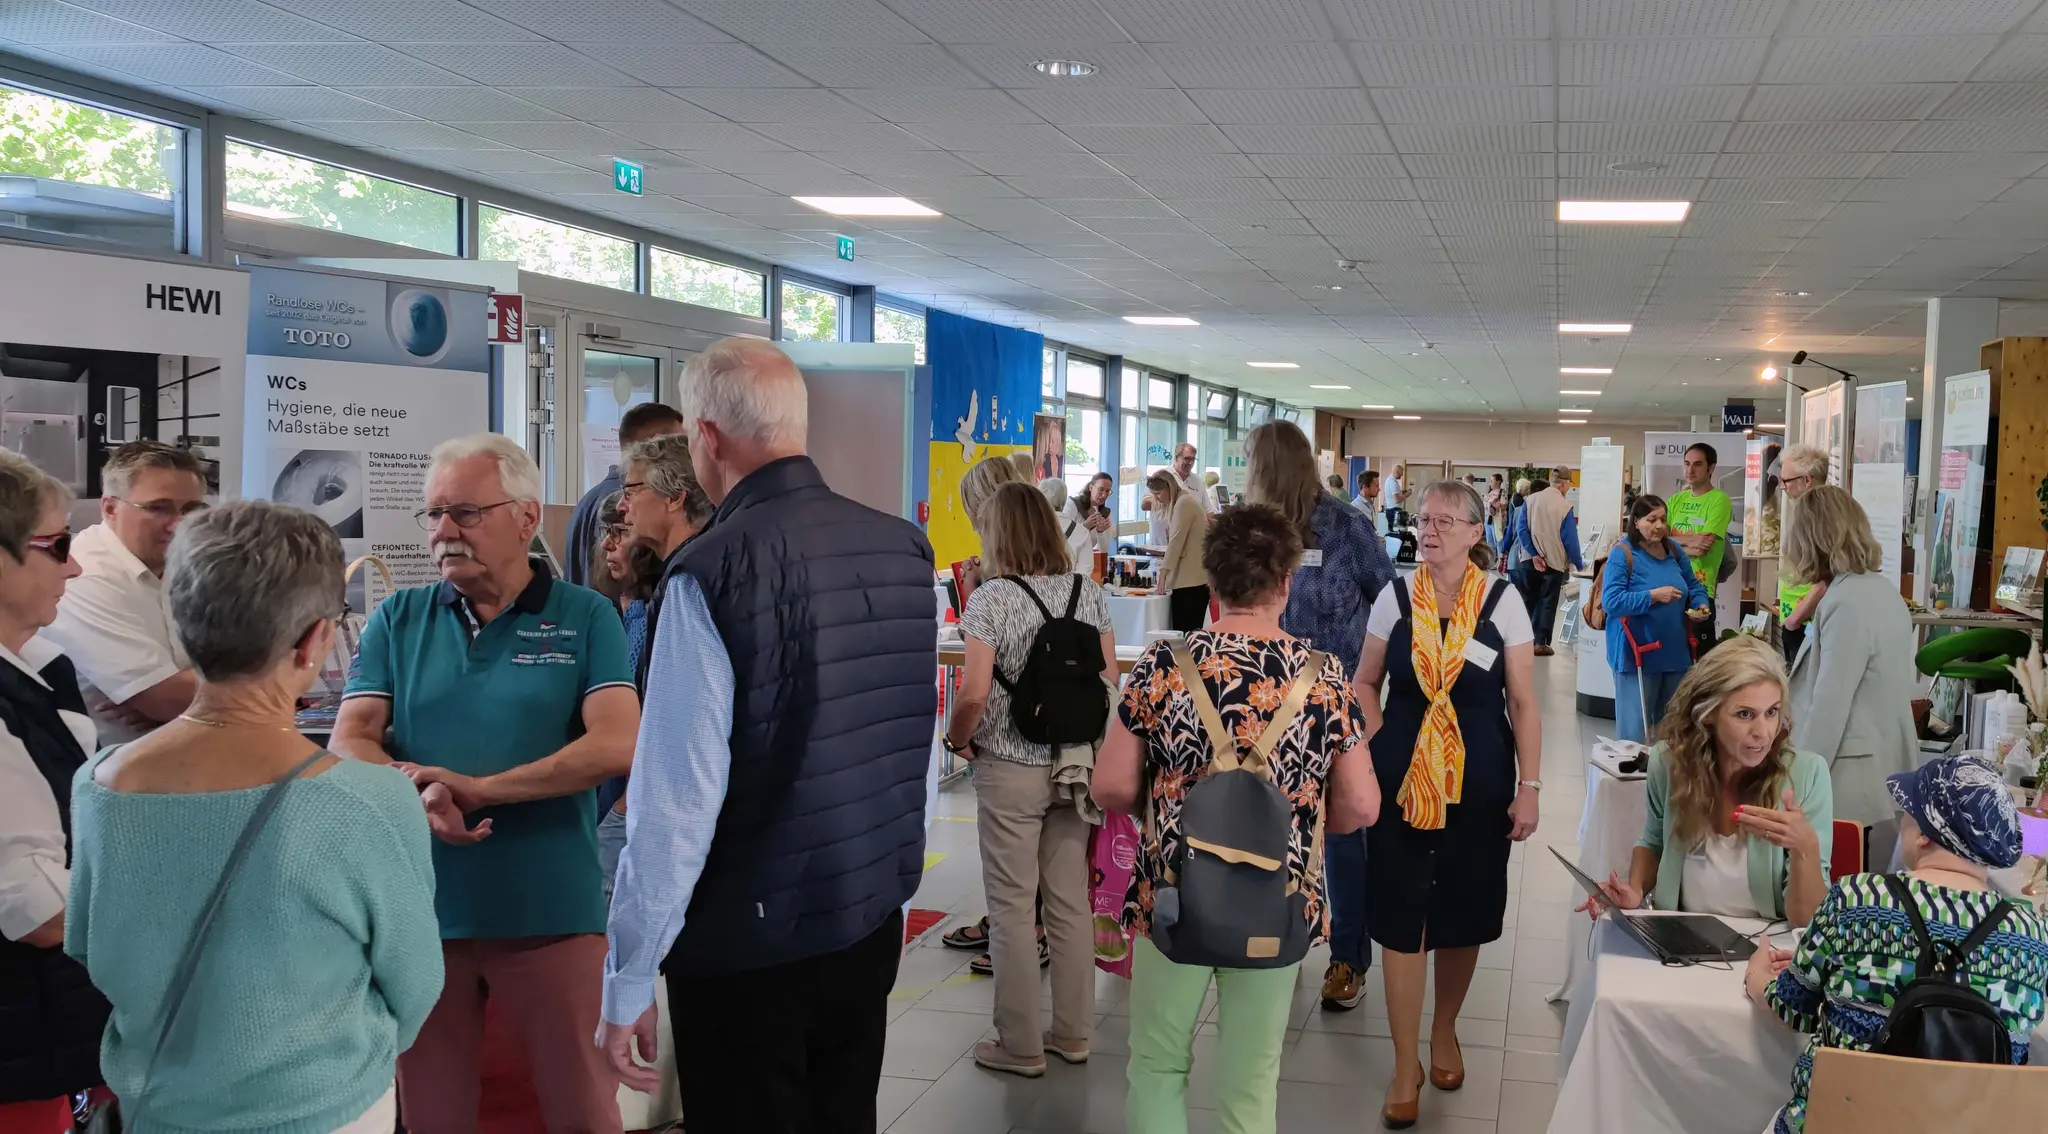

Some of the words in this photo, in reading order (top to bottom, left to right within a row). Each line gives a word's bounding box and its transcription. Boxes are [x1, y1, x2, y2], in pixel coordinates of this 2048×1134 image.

[146, 283, 221, 315] HEWI
[267, 293, 322, 309] Randlose
[325, 301, 354, 313] WCs
[282, 310, 302, 319] 2002
[319, 313, 351, 325] Original
[283, 327, 350, 348] TOTO
[267, 375, 307, 391] WCs
[267, 398, 337, 417] Hygiene,
[342, 402, 366, 417] die
[371, 407, 407, 419] neue
[267, 418, 349, 435] Maßstäbe
[353, 424, 390, 437] setzt
[369, 451, 408, 460] TORNADO
[369, 460, 382, 468] Die
[383, 461, 418, 469] kraftvolle
[1682, 502, 1701, 511] TEAM
